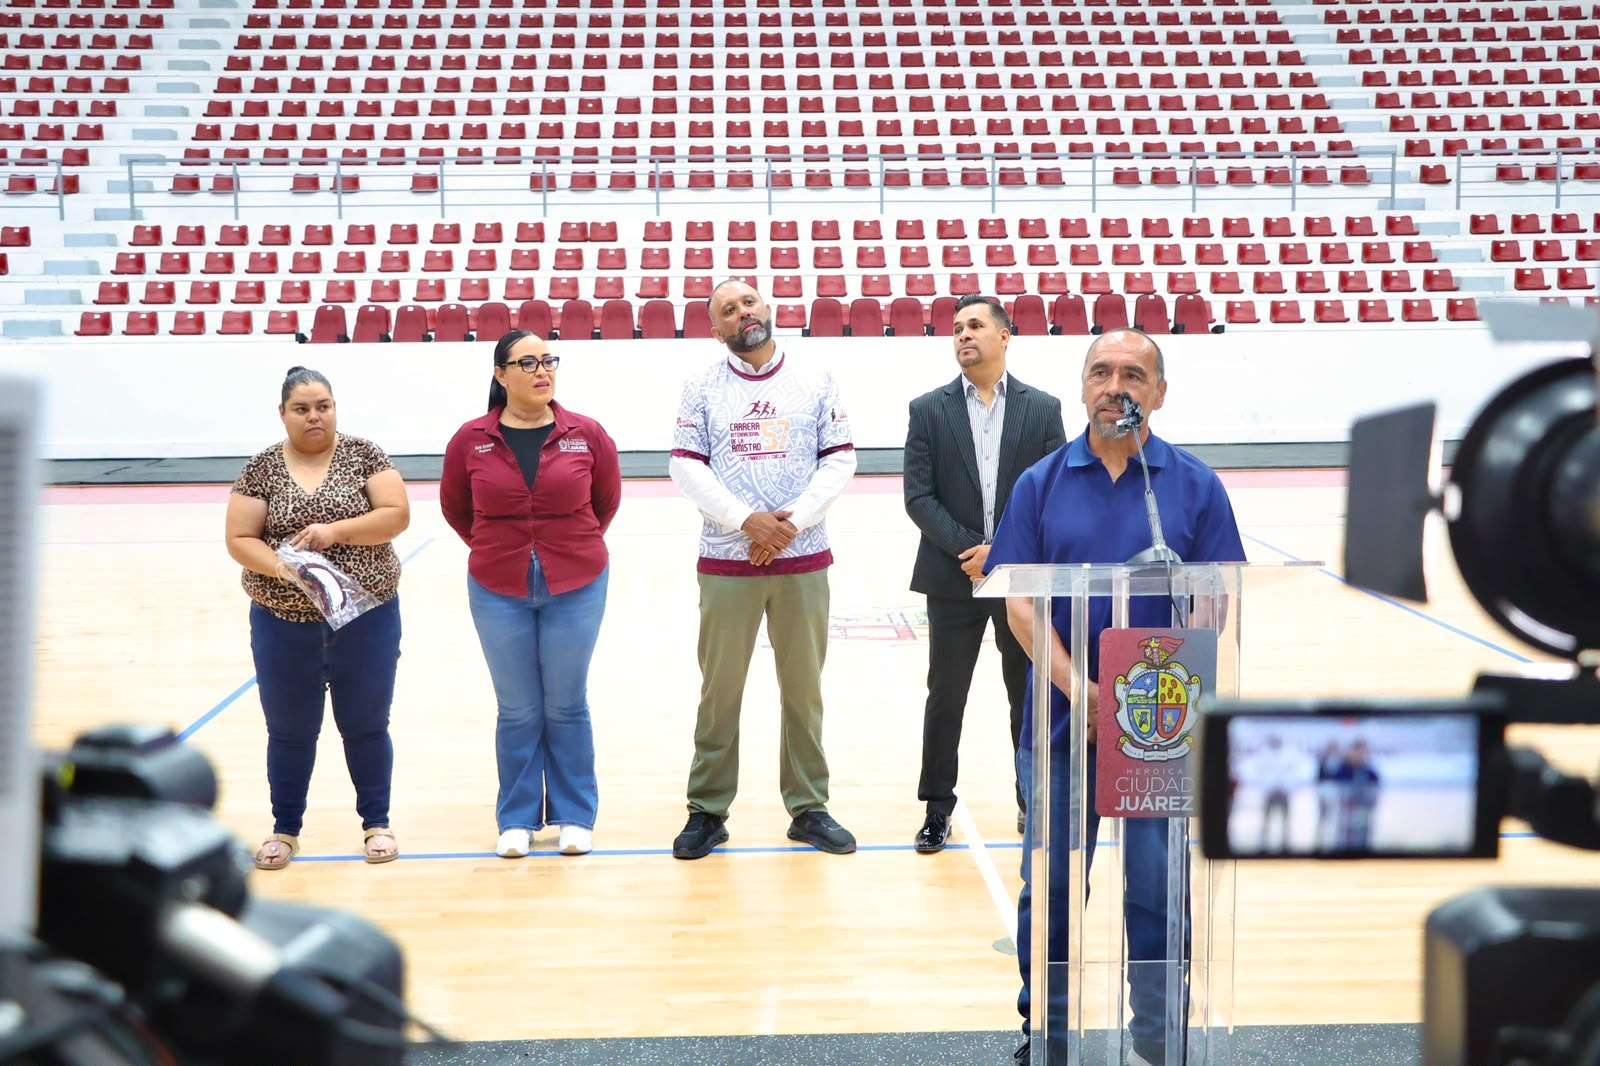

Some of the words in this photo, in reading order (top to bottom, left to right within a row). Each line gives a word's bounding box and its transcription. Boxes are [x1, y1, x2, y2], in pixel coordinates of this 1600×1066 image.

[729, 422, 760, 431] CARRERA
[761, 419, 790, 450] 57
[731, 443, 762, 453] AMISTAD
[1115, 776, 1195, 792] CIUDAD
[1114, 792, 1195, 811] JUÁREZ
